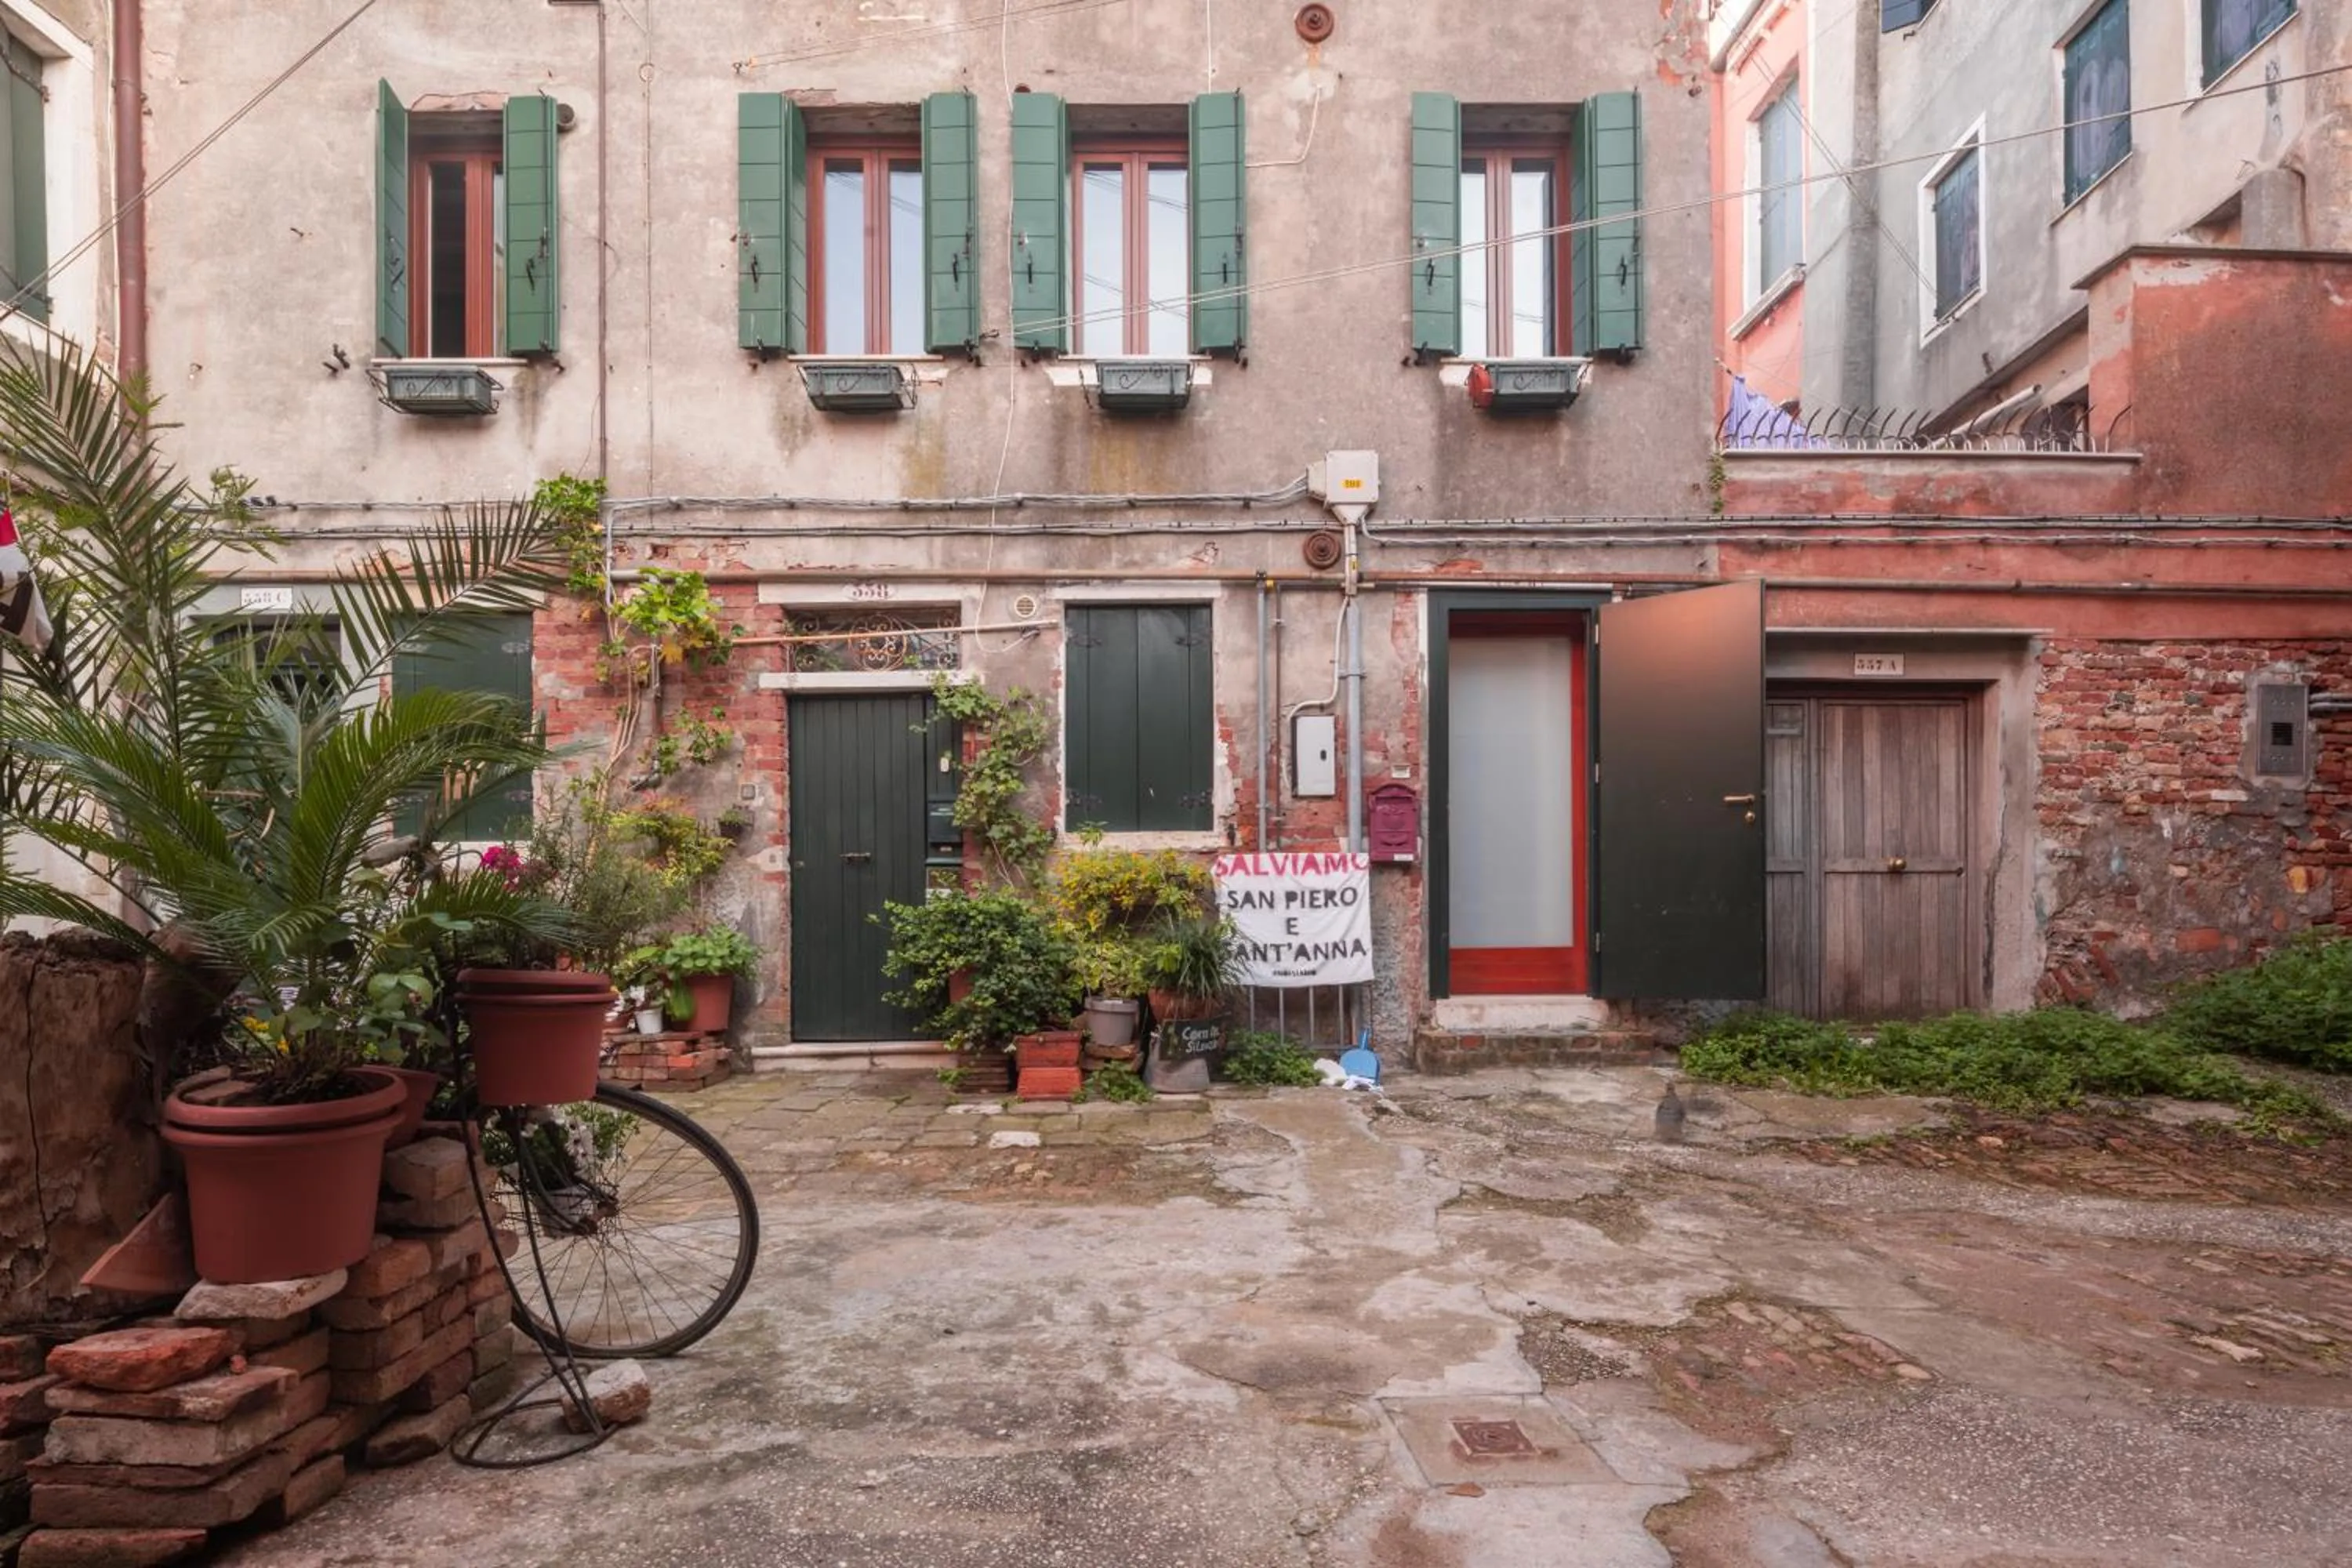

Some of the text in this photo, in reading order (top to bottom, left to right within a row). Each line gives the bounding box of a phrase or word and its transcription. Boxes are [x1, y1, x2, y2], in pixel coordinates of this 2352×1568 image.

[1856, 659, 1882, 670] 557
[1215, 852, 1370, 877] SALVIAMO
[1228, 887, 1358, 909] SAN PIERO
[1287, 917, 1299, 935] E
[1221, 938, 1367, 963] ANT'ANNA
